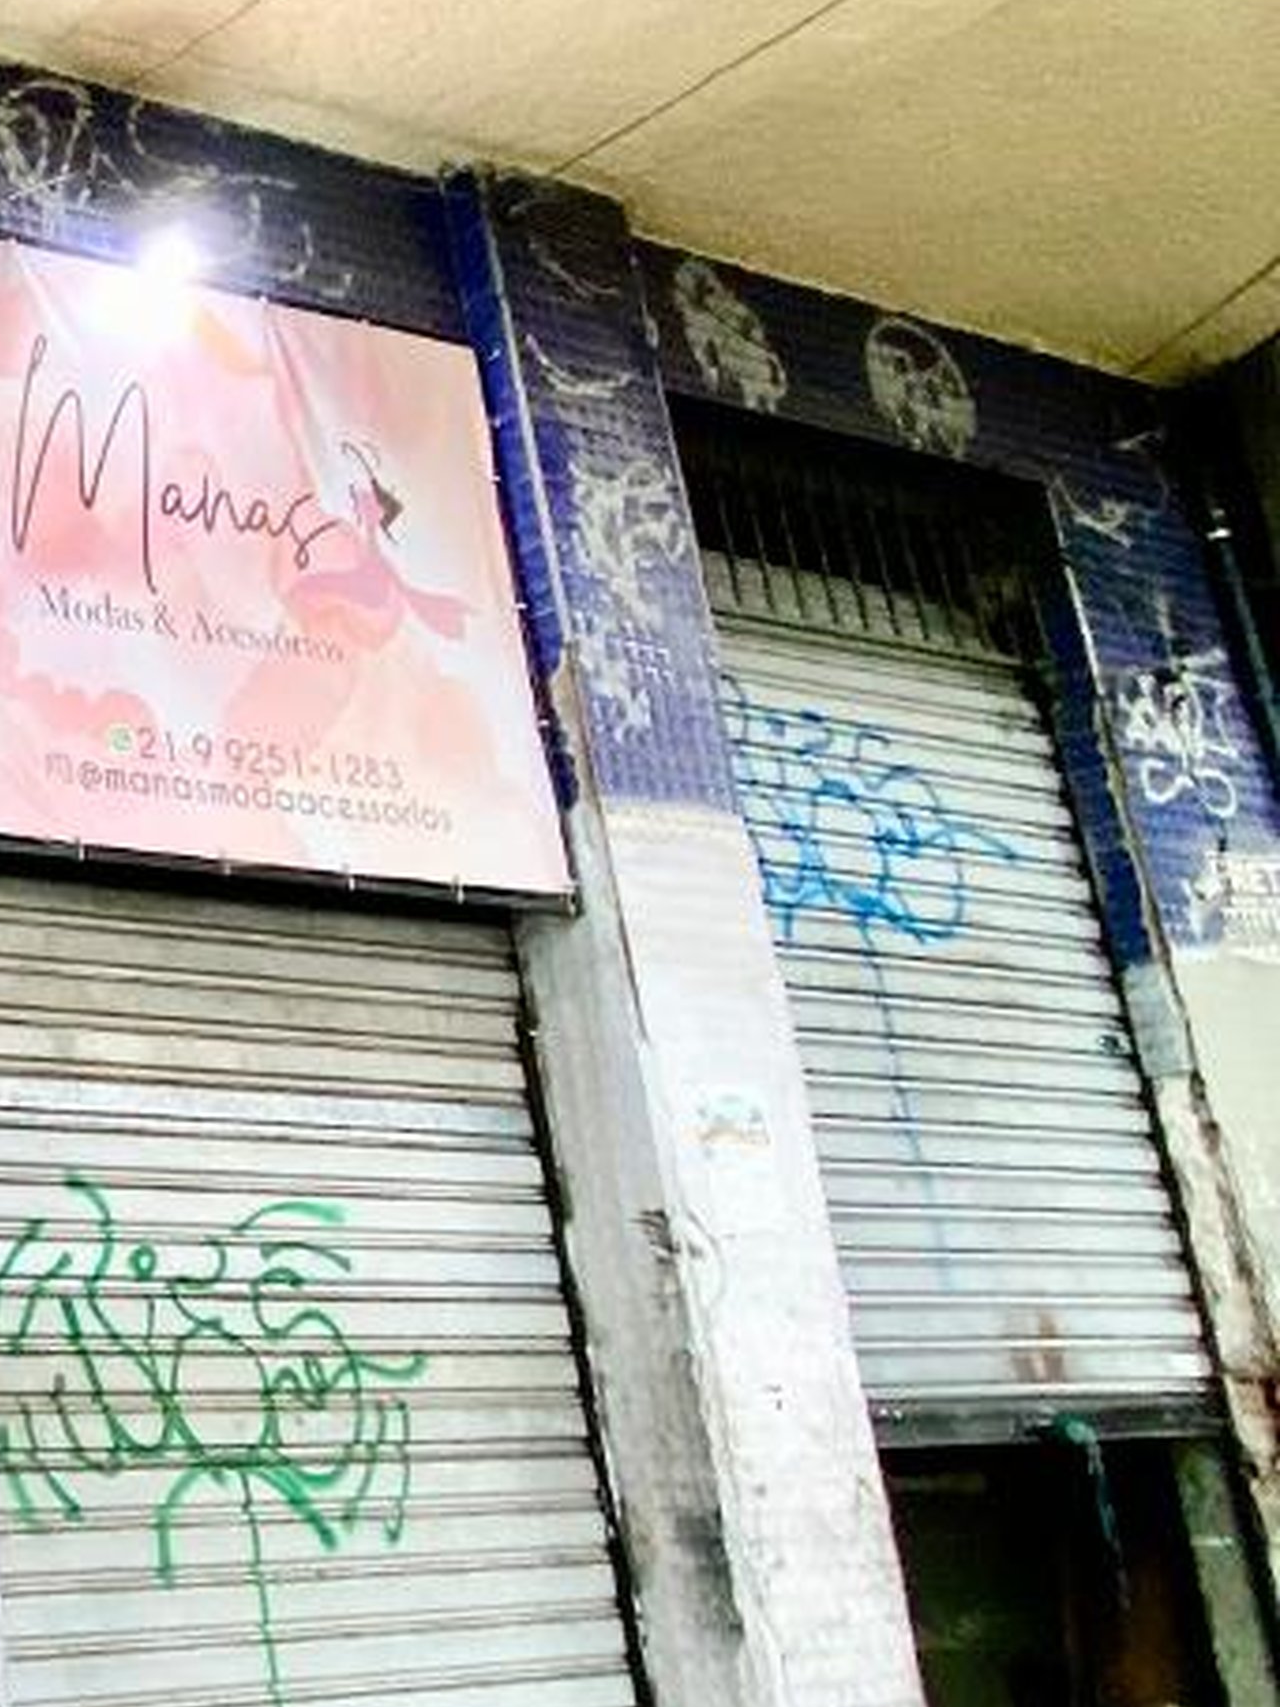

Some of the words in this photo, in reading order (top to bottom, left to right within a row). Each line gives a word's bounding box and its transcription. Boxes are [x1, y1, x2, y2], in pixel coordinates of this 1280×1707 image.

[11, 333, 340, 595] Manas
[40, 584, 145, 632] Modas
[153, 600, 180, 641] &
[224, 737, 405, 792] 9251-1283
